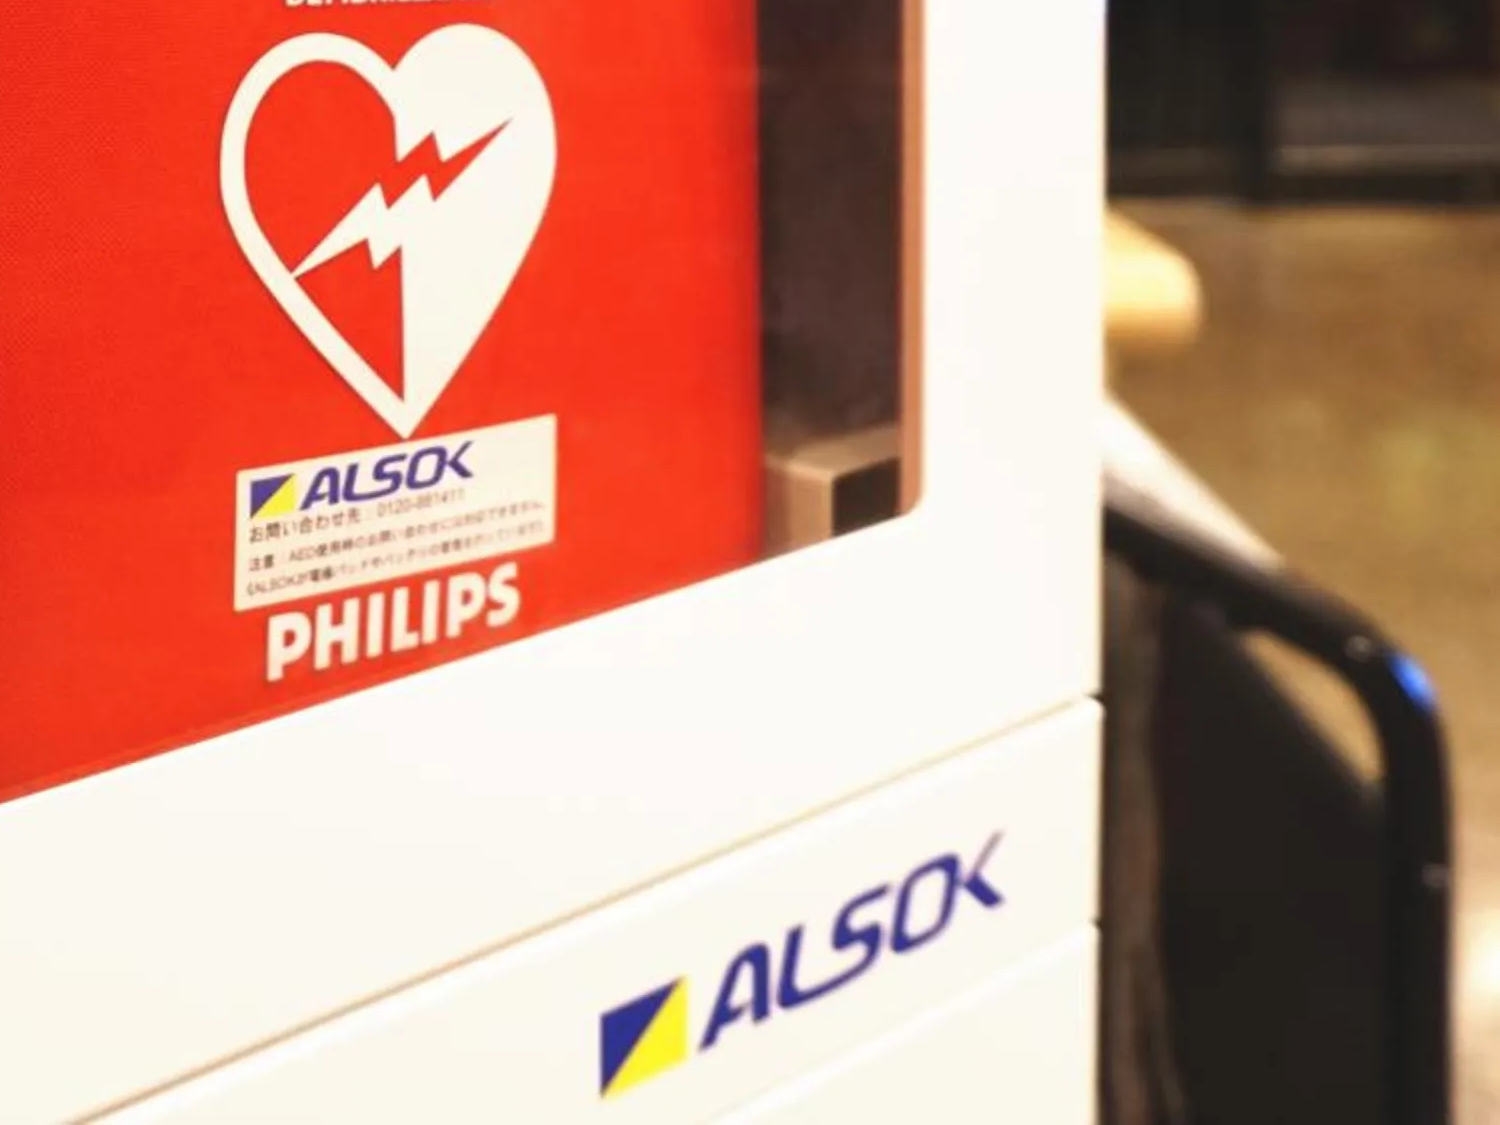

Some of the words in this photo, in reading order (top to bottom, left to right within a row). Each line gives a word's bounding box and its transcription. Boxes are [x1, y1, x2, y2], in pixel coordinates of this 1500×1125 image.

[299, 440, 474, 511] ALSOK
[266, 560, 521, 683] PHILIPS
[698, 828, 1005, 1053] ALSOK
